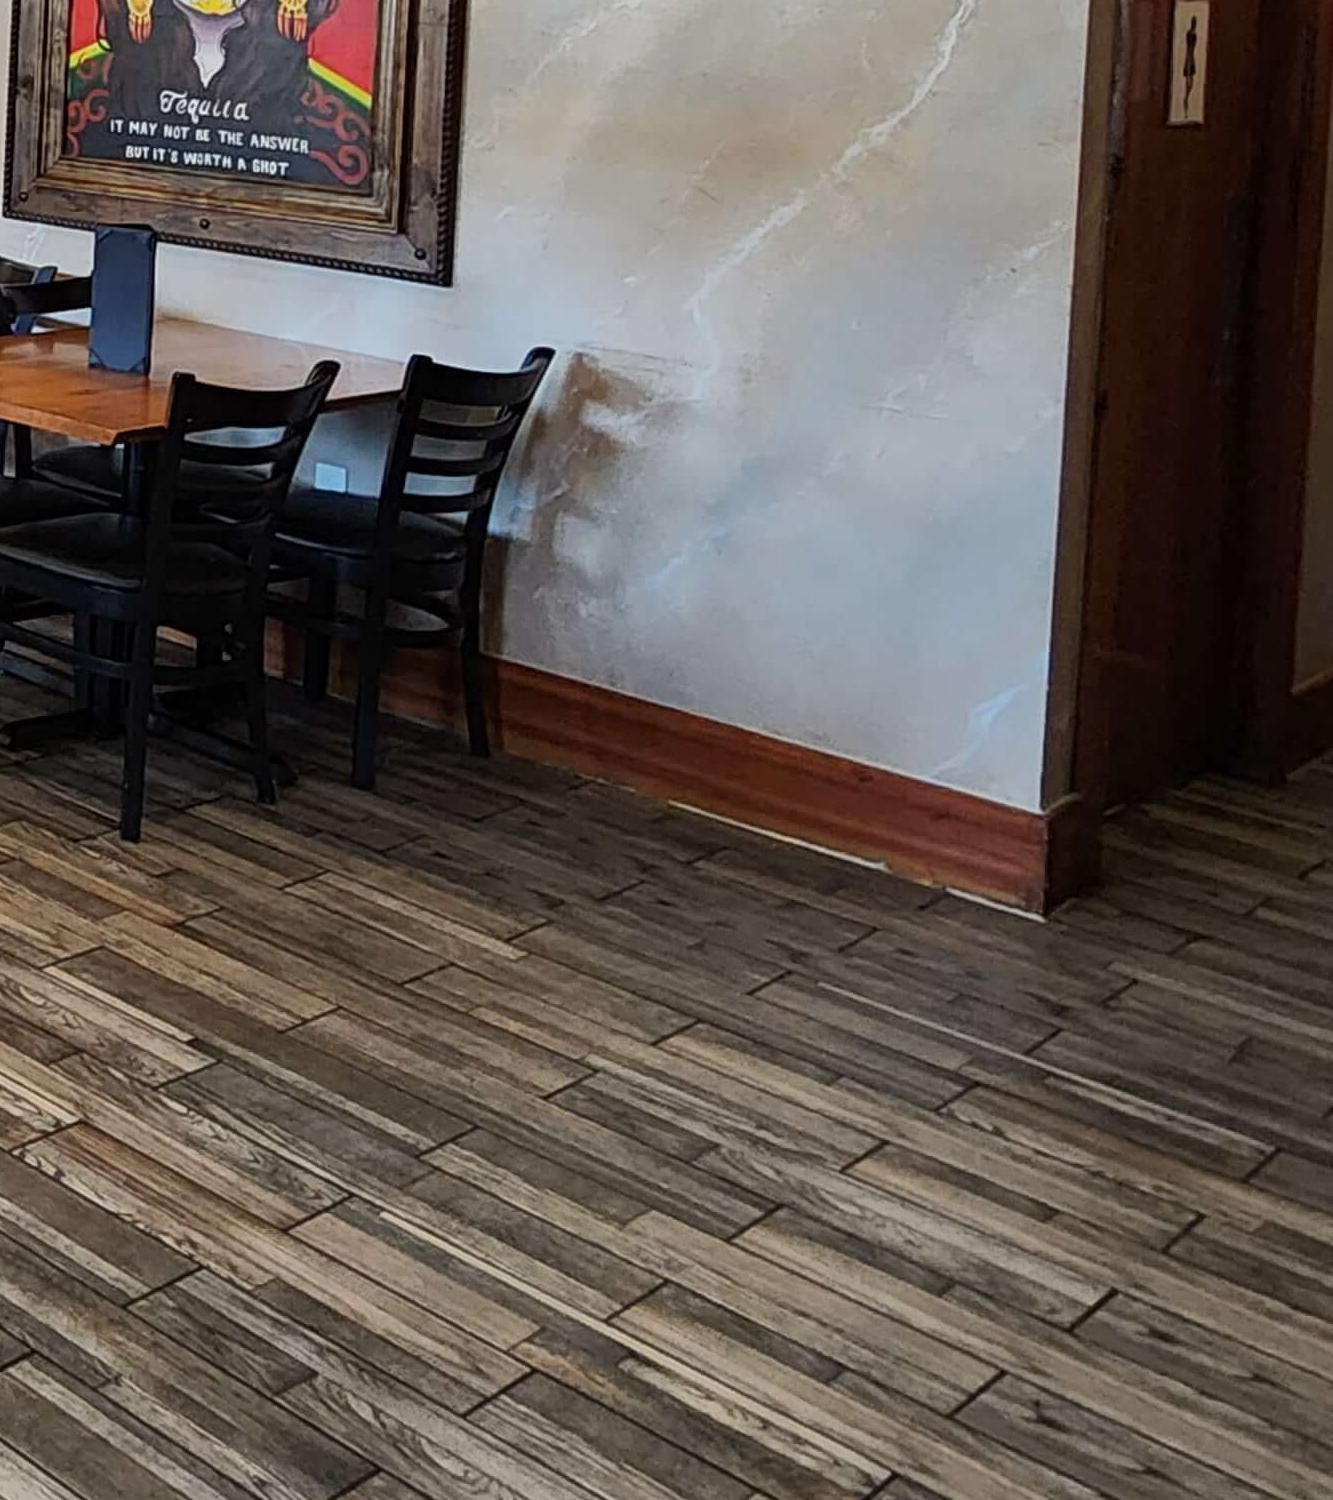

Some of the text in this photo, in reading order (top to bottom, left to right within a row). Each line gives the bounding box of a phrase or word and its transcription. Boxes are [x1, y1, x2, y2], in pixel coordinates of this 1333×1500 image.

[159, 90, 250, 123] Tequila
[110, 119, 310, 155] IT MAY NOT BE THE ANSWER
[125, 145, 290, 177] BUT IT'S WORTH A SHOT
